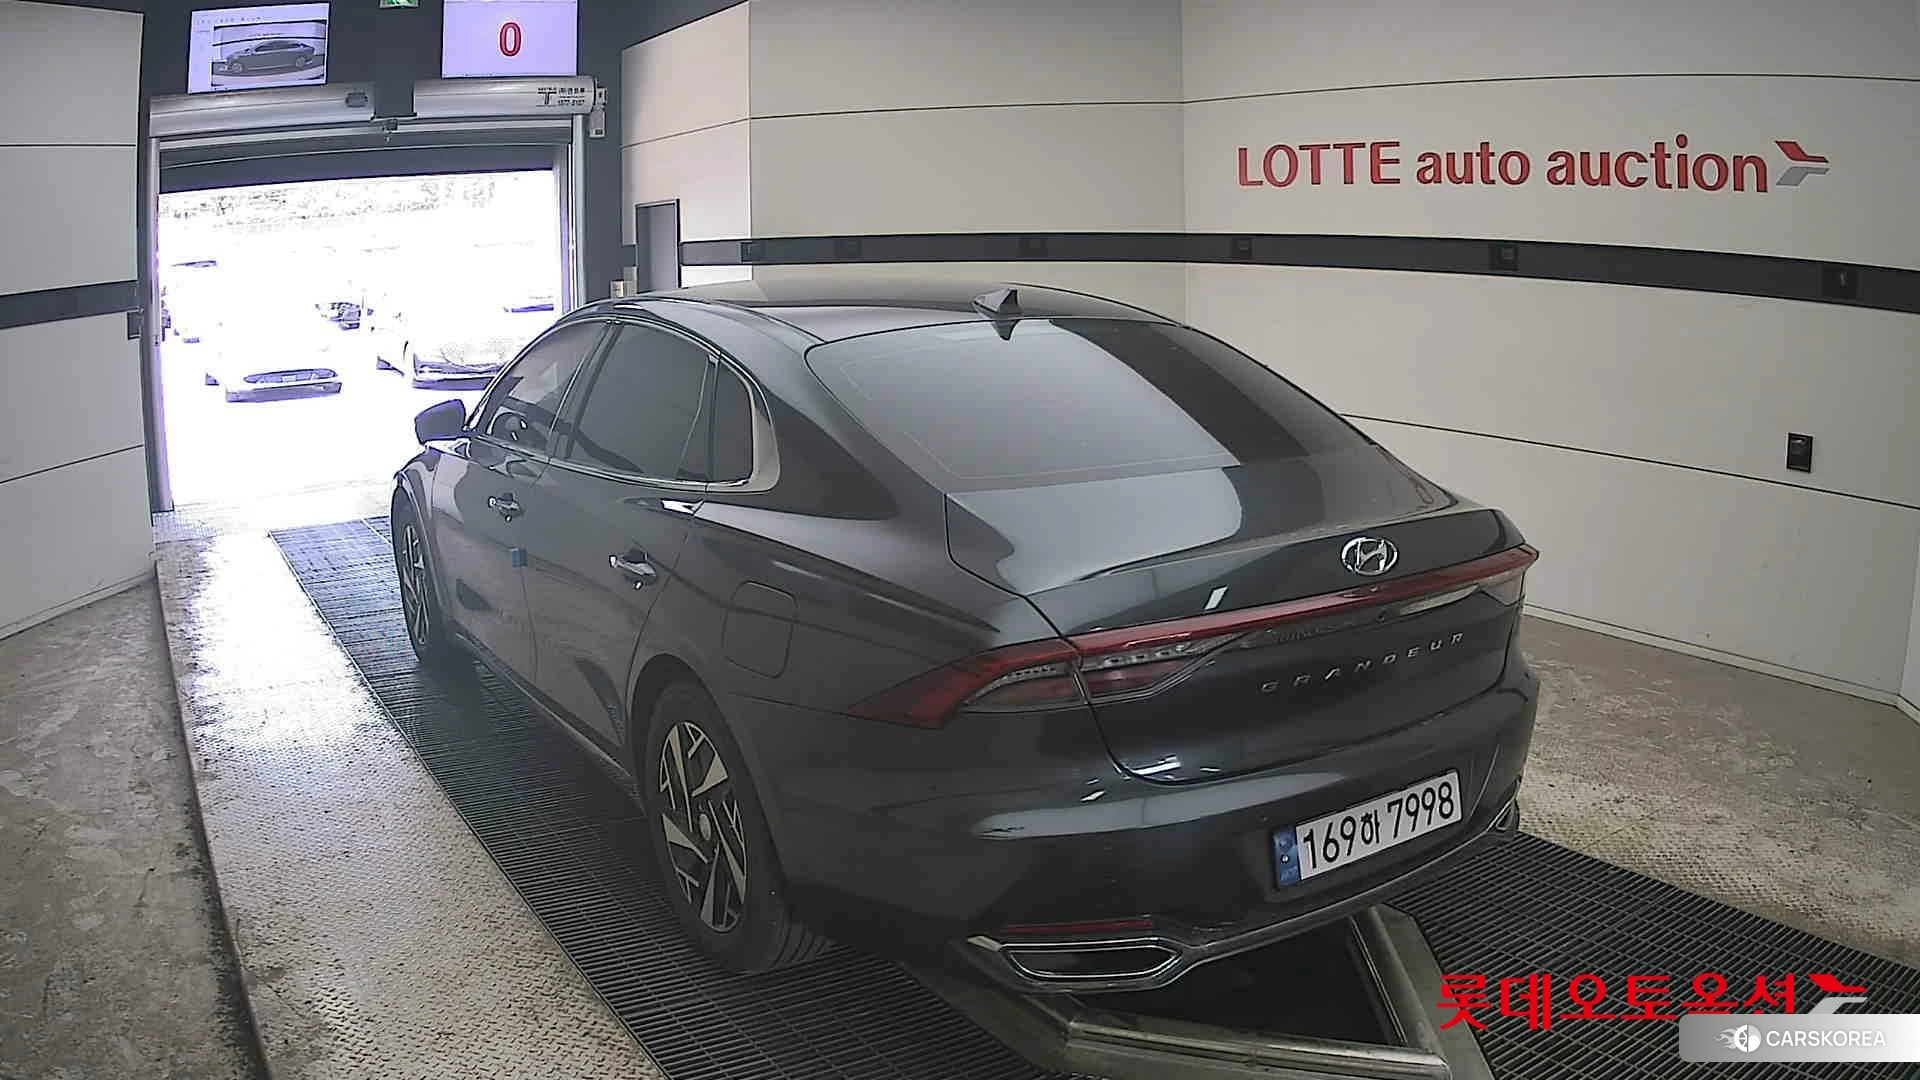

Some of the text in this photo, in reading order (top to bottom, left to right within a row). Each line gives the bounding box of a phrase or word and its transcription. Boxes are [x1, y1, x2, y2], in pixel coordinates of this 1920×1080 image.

[499, 22, 522, 57] 0
[1238, 134, 1768, 193] LOTTE auto auction
[1261, 632, 1464, 692] GRANDEUR
[1303, 781, 1454, 869] 169하 7998
